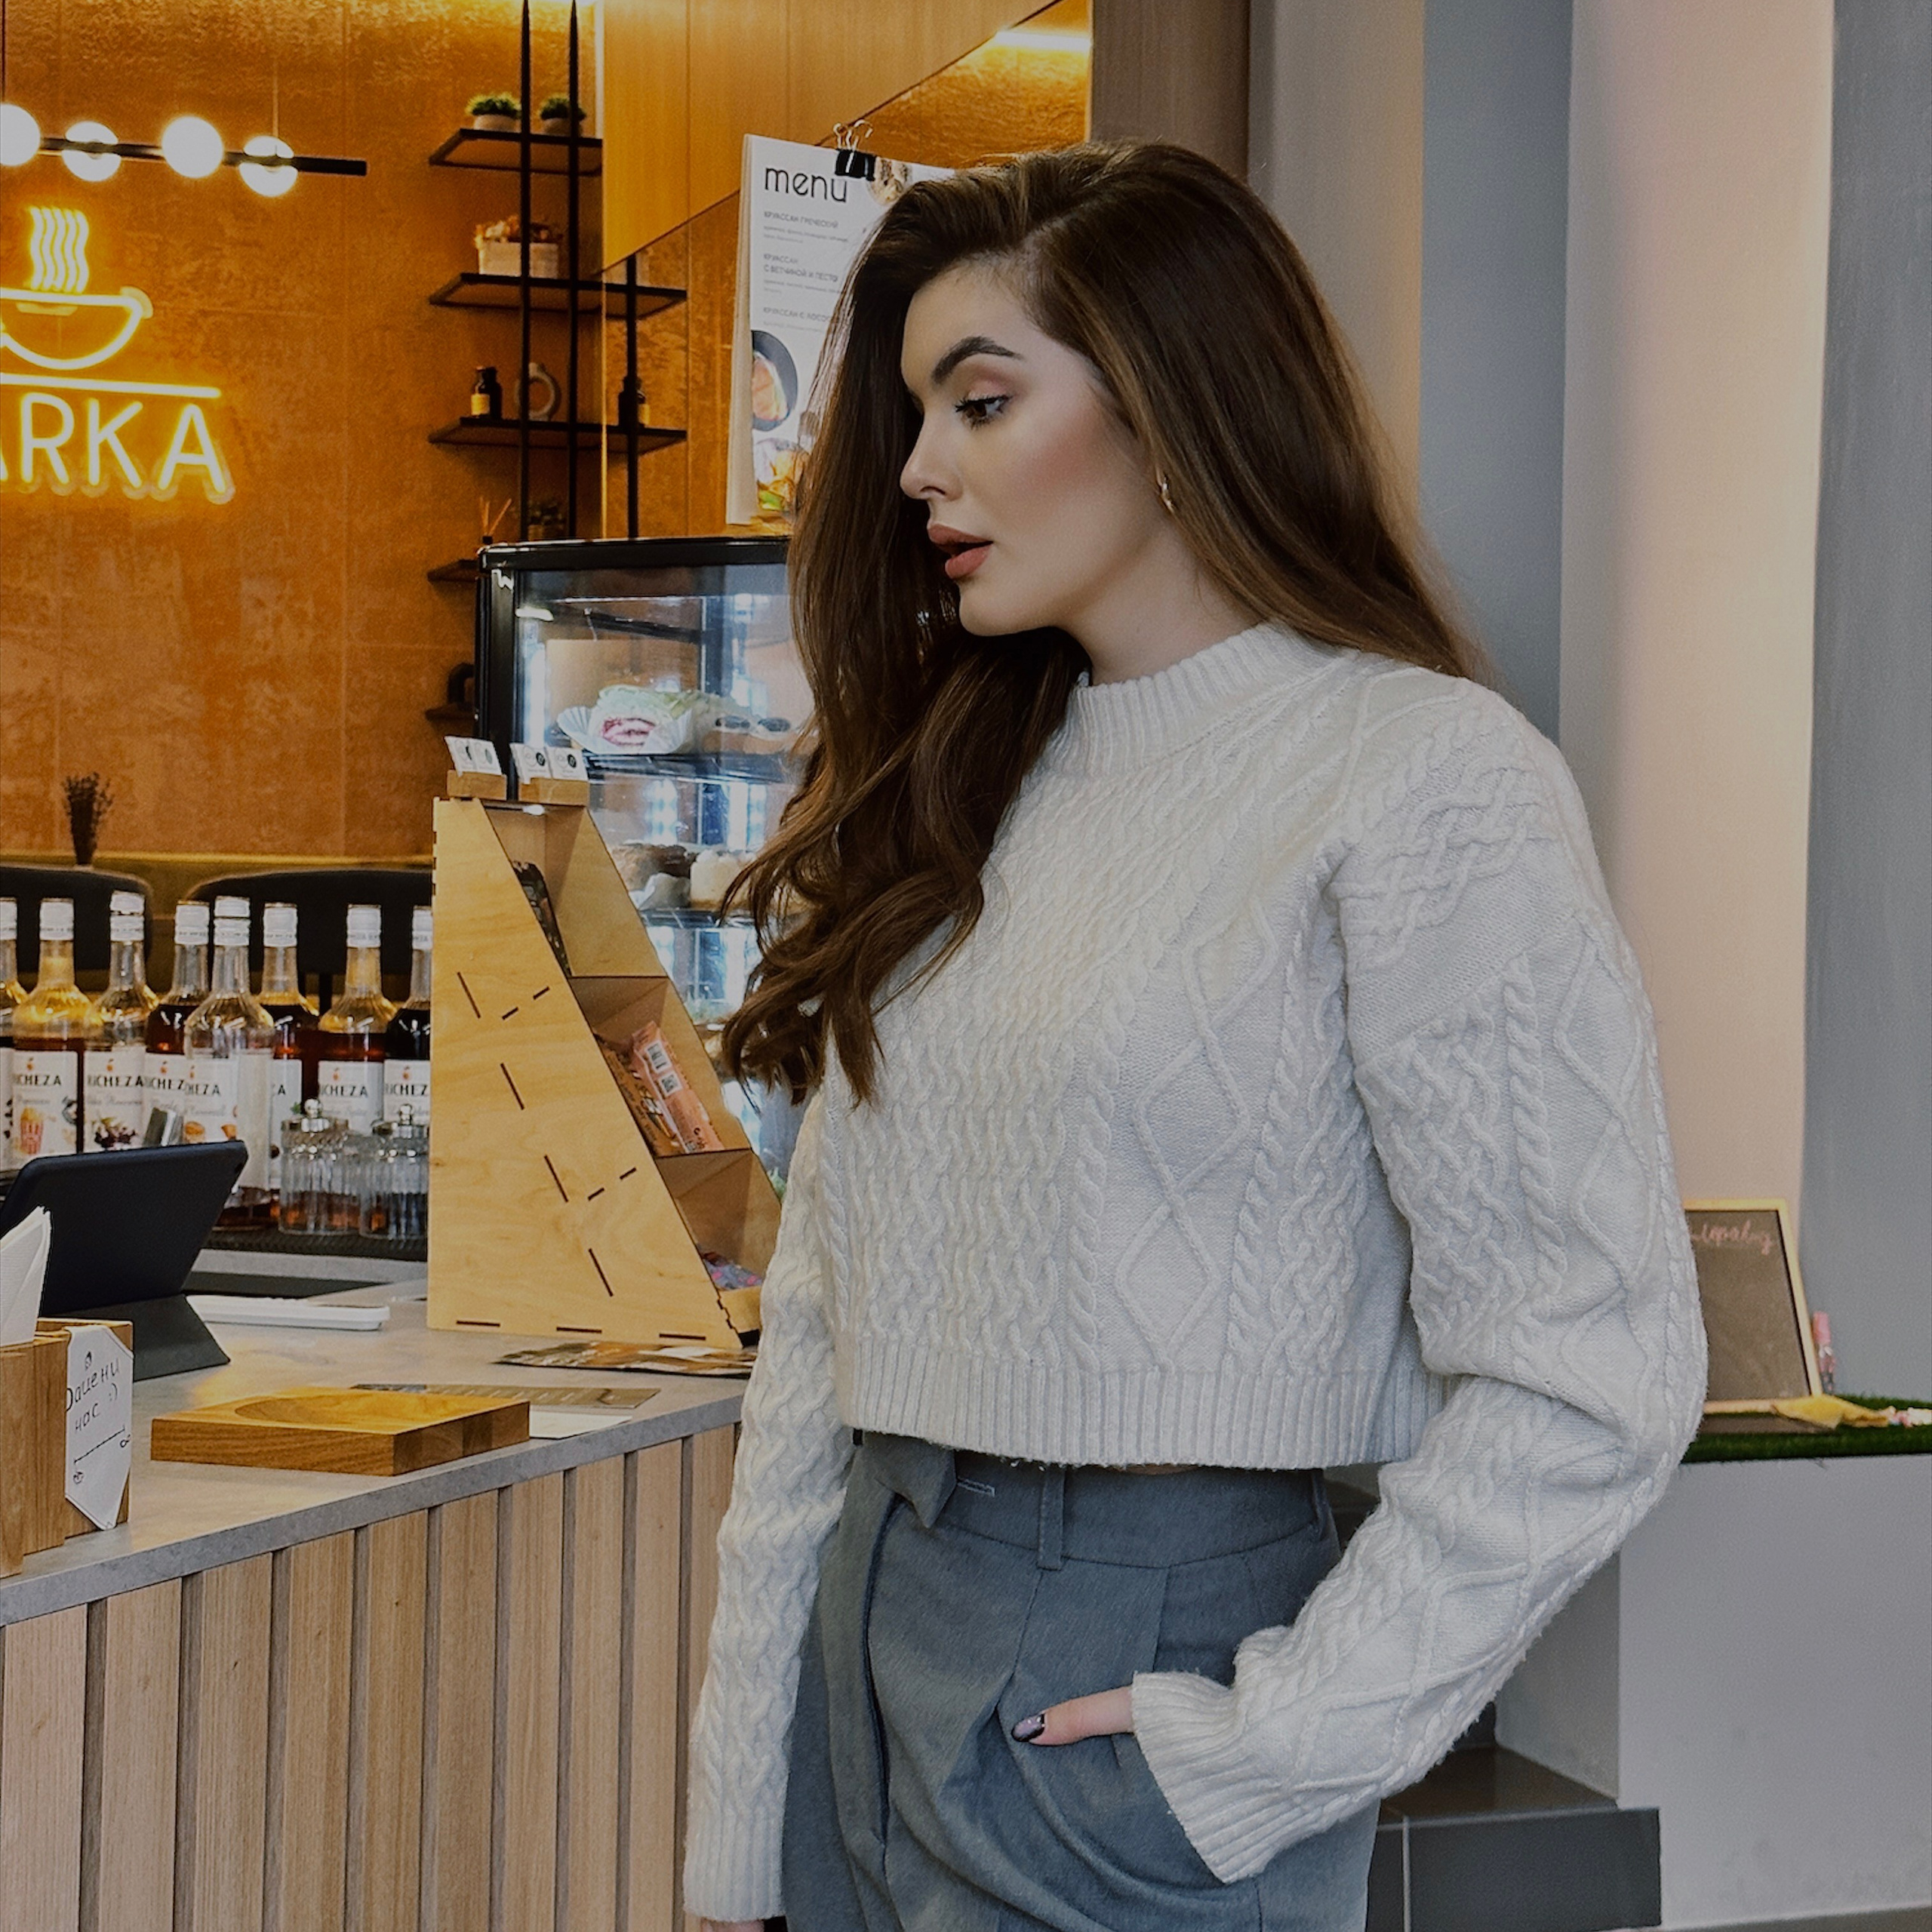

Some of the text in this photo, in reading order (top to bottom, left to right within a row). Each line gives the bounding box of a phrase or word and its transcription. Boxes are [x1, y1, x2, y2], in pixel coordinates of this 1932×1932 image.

[764, 167, 848, 204] menu
[0, 392, 231, 497] RKA
[75, 1402, 100, 1432] нас
